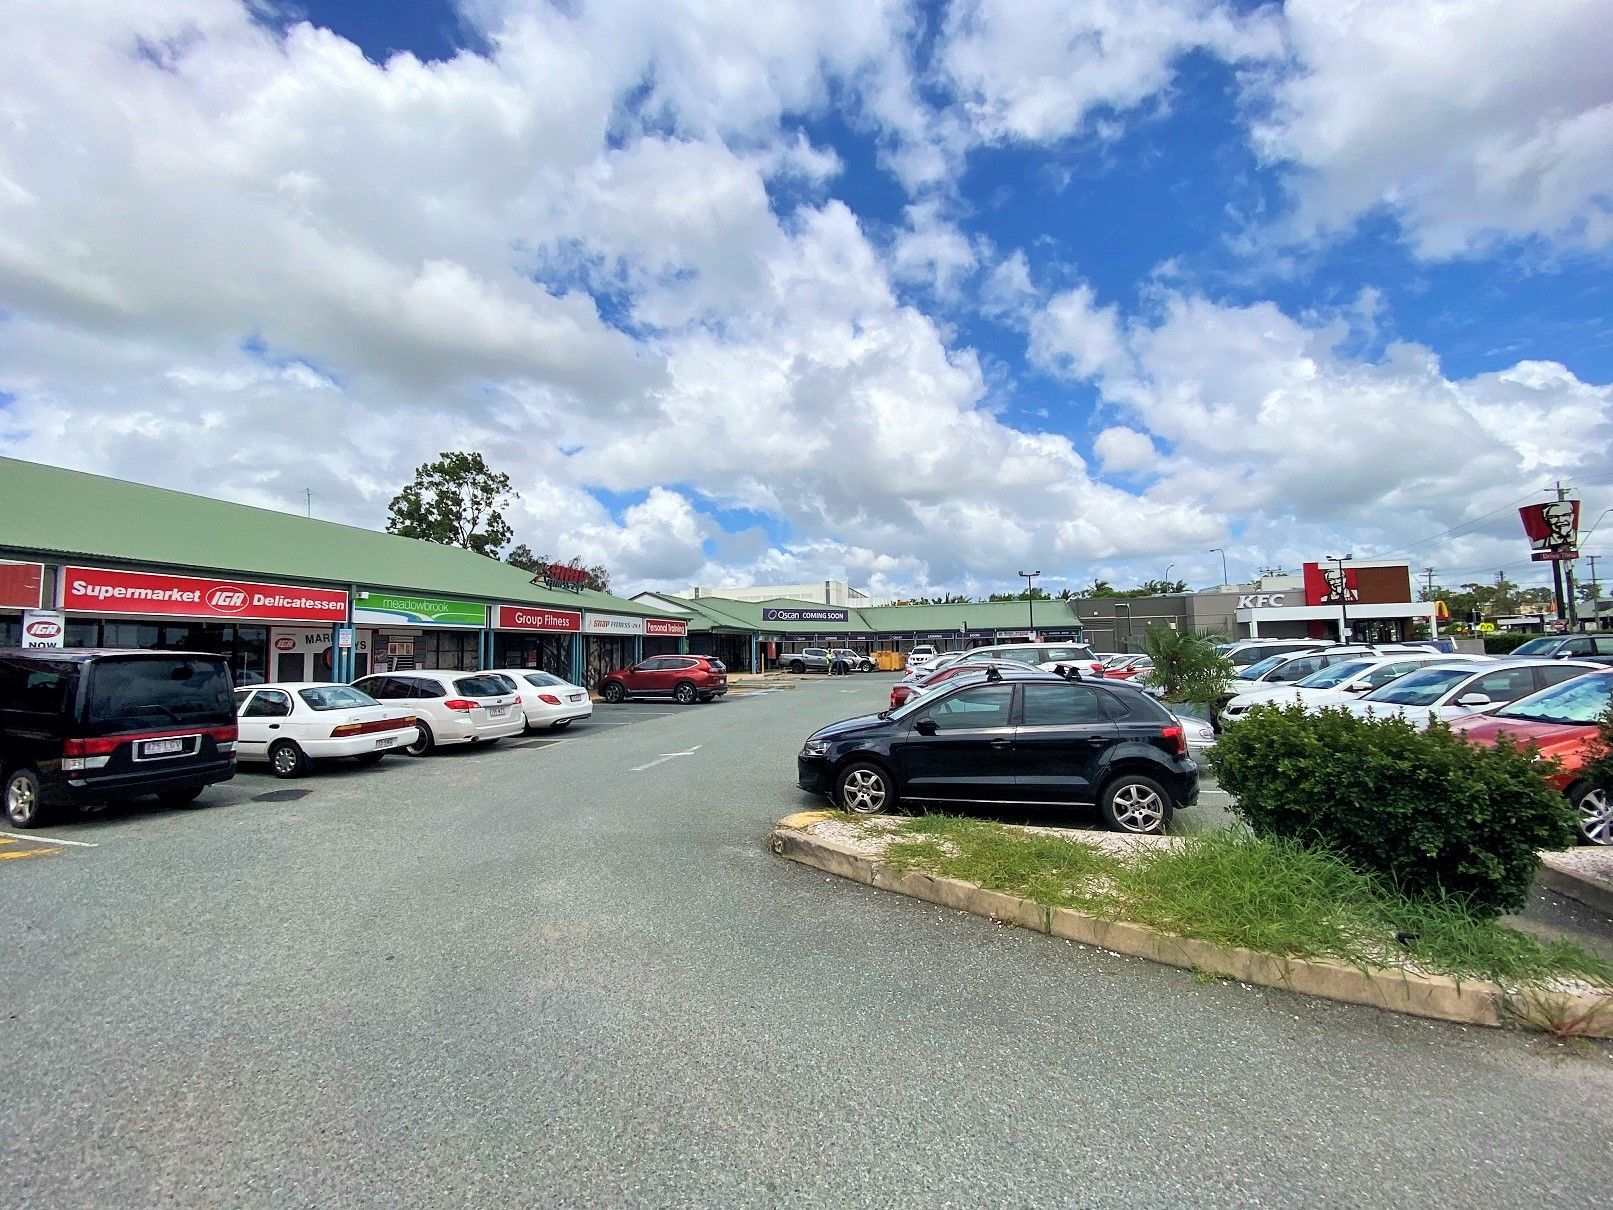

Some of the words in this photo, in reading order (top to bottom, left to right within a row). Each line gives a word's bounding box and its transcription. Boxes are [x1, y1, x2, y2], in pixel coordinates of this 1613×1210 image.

[71, 580, 201, 602] Supermarket
[211, 591, 245, 606] IGA
[253, 594, 344, 611] Delicatessen
[1236, 594, 1285, 609] KFC
[383, 599, 448, 612] meadowbrook
[515, 612, 543, 627] Group
[544, 615, 570, 627] Fitness
[778, 611, 800, 620] Qscan
[30, 624, 59, 635] IGA
[647, 622, 668, 632] Personal
[668, 623, 685, 634] Training
